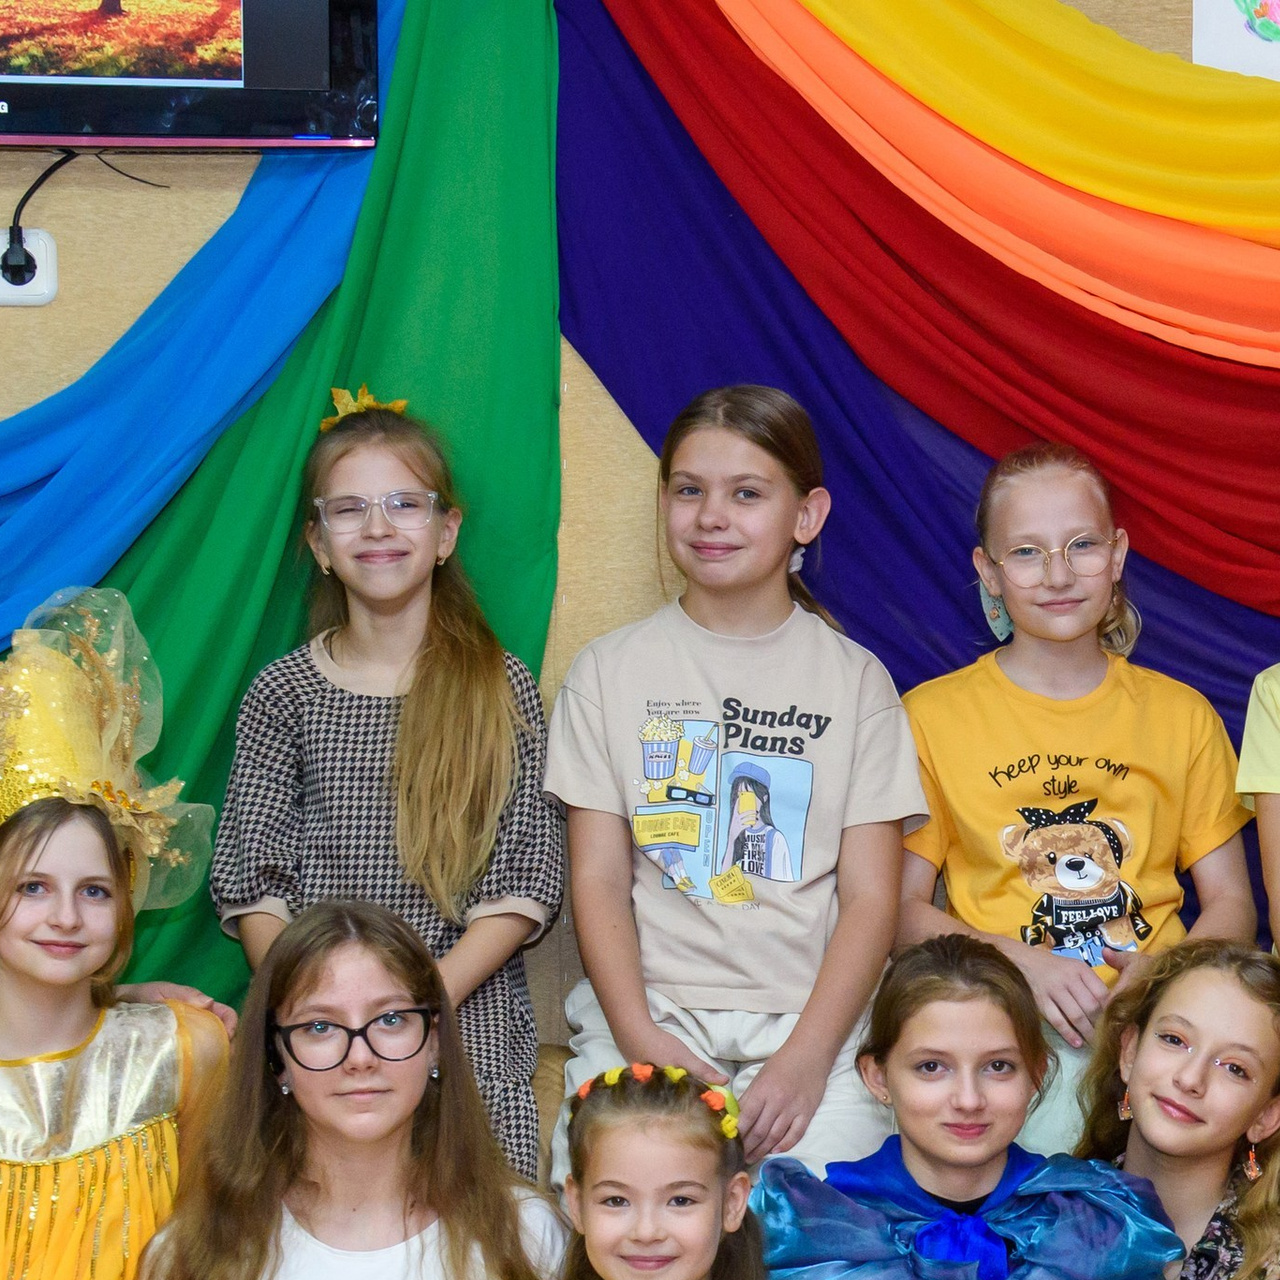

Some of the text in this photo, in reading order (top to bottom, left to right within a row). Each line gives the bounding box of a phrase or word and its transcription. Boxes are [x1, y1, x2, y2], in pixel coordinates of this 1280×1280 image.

[646, 699, 702, 709] Enjoy where
[722, 697, 832, 740] Sunday
[722, 723, 806, 756] Plans
[988, 753, 1130, 788] Keep your own
[1042, 775, 1080, 799] style
[741, 860, 765, 876] LOVE
[742, 850, 766, 863] FIRST
